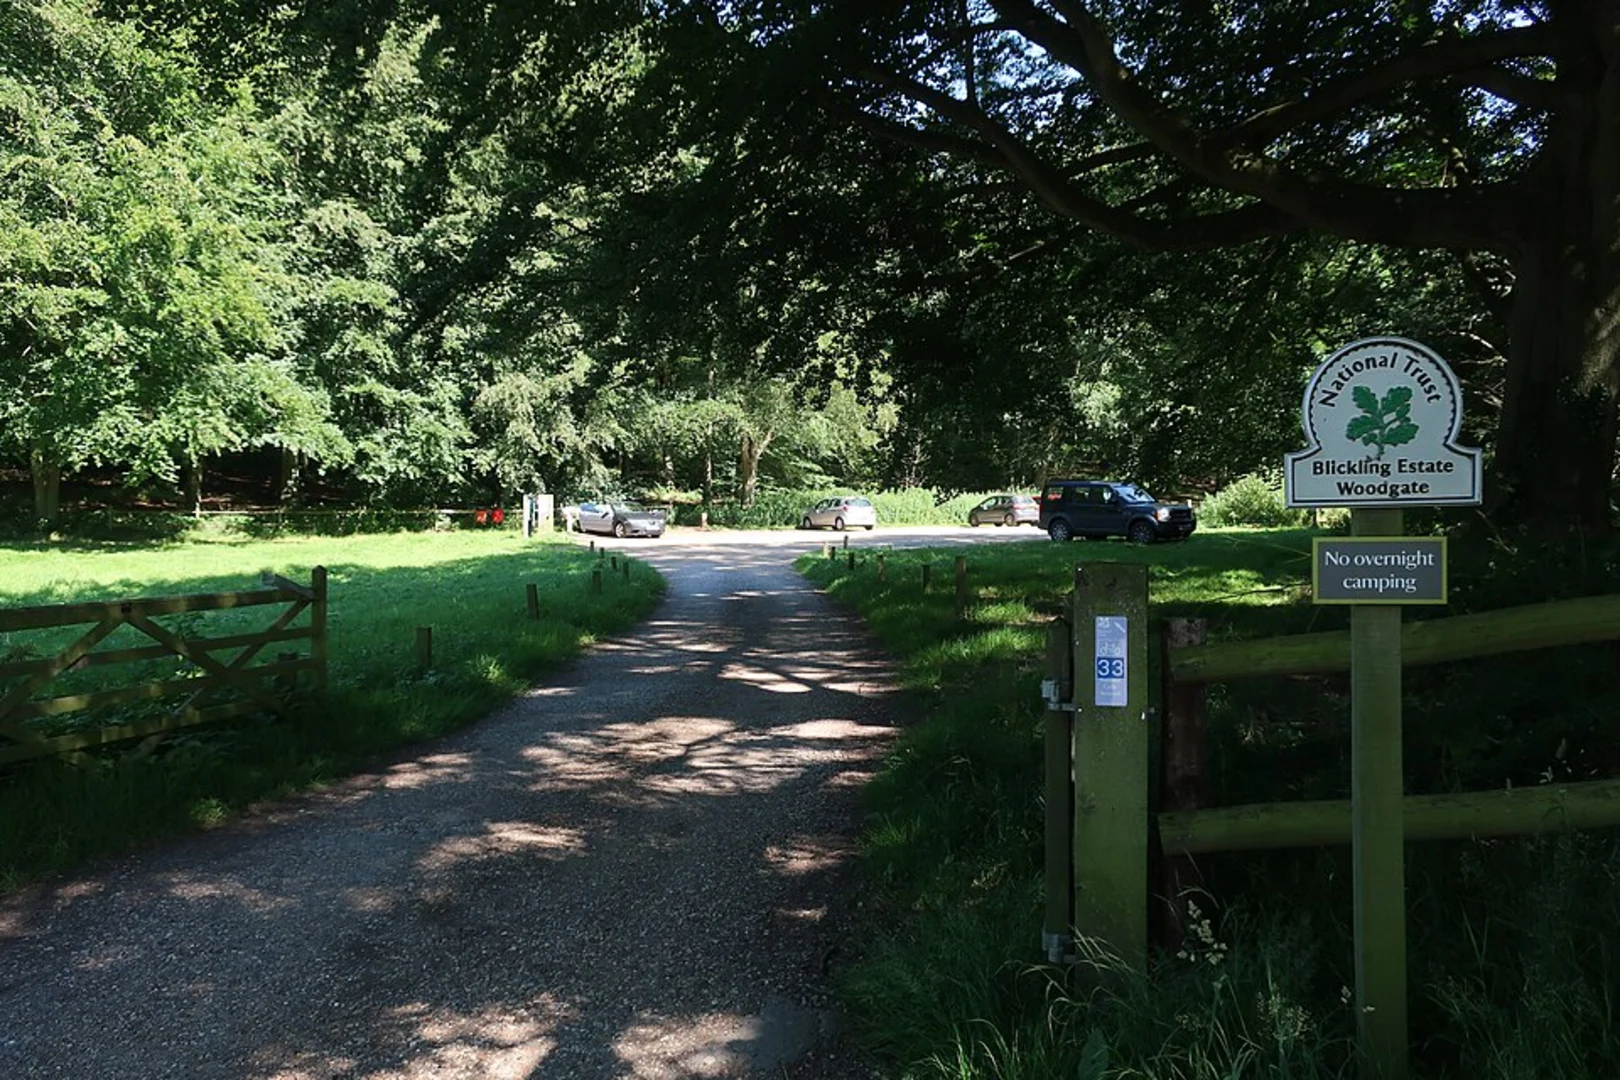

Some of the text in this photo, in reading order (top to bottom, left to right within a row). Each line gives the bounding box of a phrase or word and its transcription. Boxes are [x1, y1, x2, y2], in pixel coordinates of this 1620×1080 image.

[1319, 352, 1441, 407] National Trust
[1312, 458, 1454, 477] Blickling Estate
[1336, 481, 1430, 498] Woodgate
[1324, 549, 1434, 569] No overnight
[1343, 574, 1417, 593] camping
[1098, 659, 1123, 676] 33
